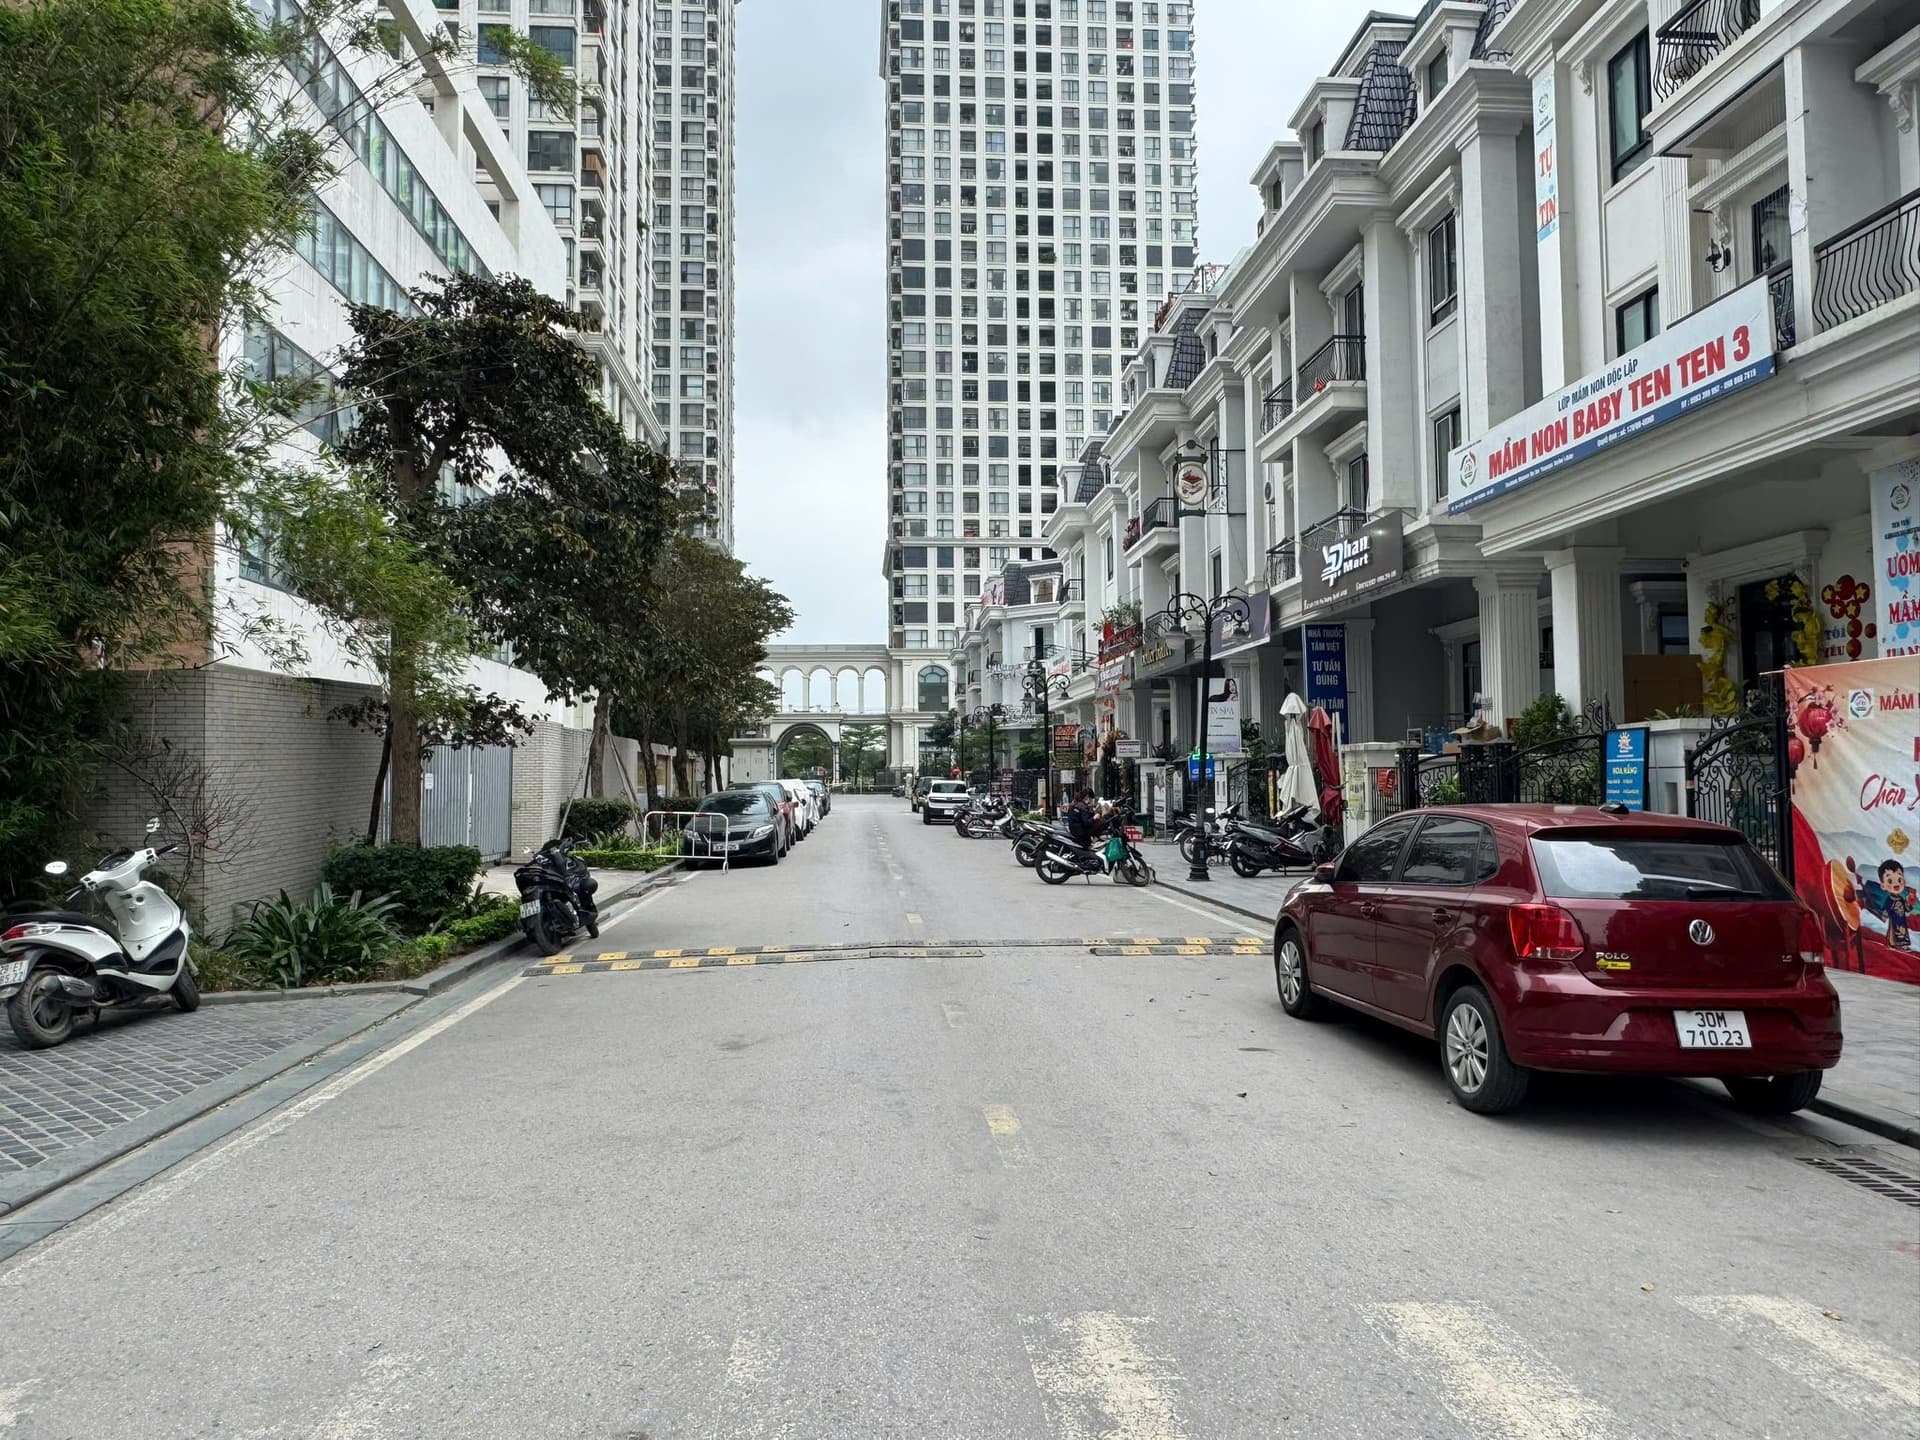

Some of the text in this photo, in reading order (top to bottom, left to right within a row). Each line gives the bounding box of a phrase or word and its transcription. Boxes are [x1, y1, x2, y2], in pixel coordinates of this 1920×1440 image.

[1539, 195, 1556, 229] TIN
[1590, 376, 1606, 395] NON
[1607, 367, 1622, 386] ĐỘC
[1623, 358, 1638, 378] LẬP
[1531, 415, 1568, 459] NON
[1573, 388, 1622, 440] BABY
[1628, 363, 1671, 412] TEN
[1676, 335, 1726, 389] TEN
[1732, 324, 1750, 362] 3
[1343, 553, 1369, 574] Mart
[1880, 687, 1914, 711] MẦM
[1861, 773, 1906, 811] Chào
[1595, 951, 1630, 960] POLO
[1695, 1011, 1728, 1028] 30M
[1686, 1029, 1744, 1046] 710.23
